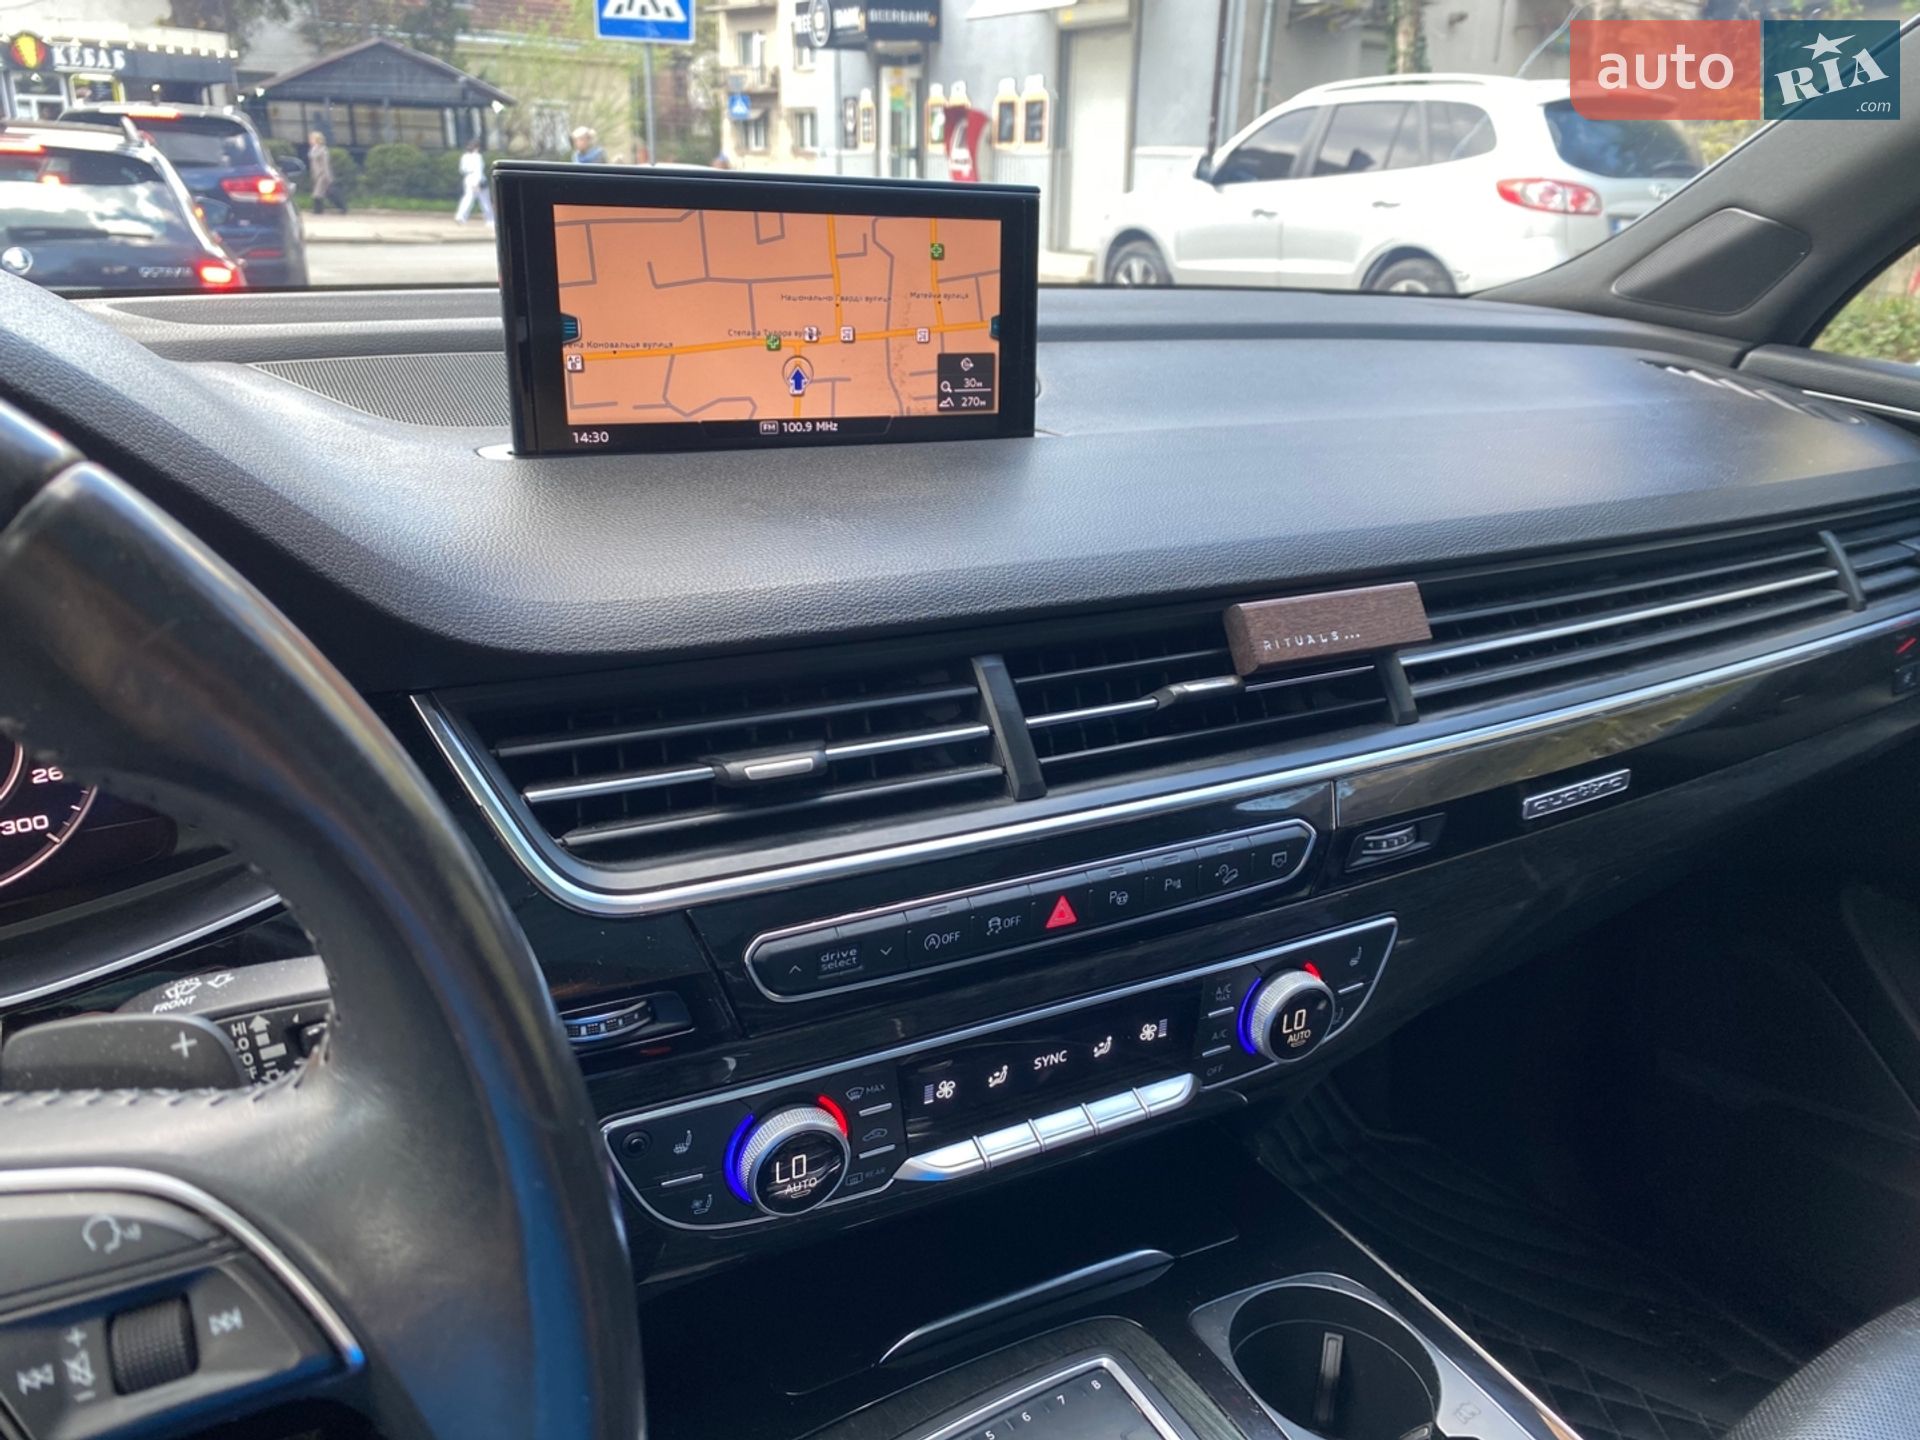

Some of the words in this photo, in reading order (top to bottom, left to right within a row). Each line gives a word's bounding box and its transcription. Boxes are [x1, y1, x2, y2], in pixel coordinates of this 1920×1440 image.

[782, 421, 813, 433] 100.9
[816, 421, 839, 432] MHz
[572, 431, 609, 444] 14:30
[32, 766, 64, 784] 26
[0, 815, 49, 835] 300
[1003, 915, 1022, 928] OFF
[942, 931, 961, 945] OFF
[820, 947, 857, 963] drive
[821, 956, 857, 972] select
[152, 995, 197, 1015] FRONT
[230, 1020, 248, 1037] HI
[1282, 1008, 1307, 1034] LO
[1286, 1029, 1312, 1044] AUTO
[1033, 1050, 1068, 1070] SYNC
[866, 1084, 885, 1095] MAX
[774, 1154, 808, 1185] LO
[785, 1177, 818, 1196] AUTO
[1091, 1379, 1102, 1390] 8
[1056, 1395, 1065, 1405] 7
[1021, 1412, 1031, 1422] 6
[985, 1430, 995, 1440] 5
